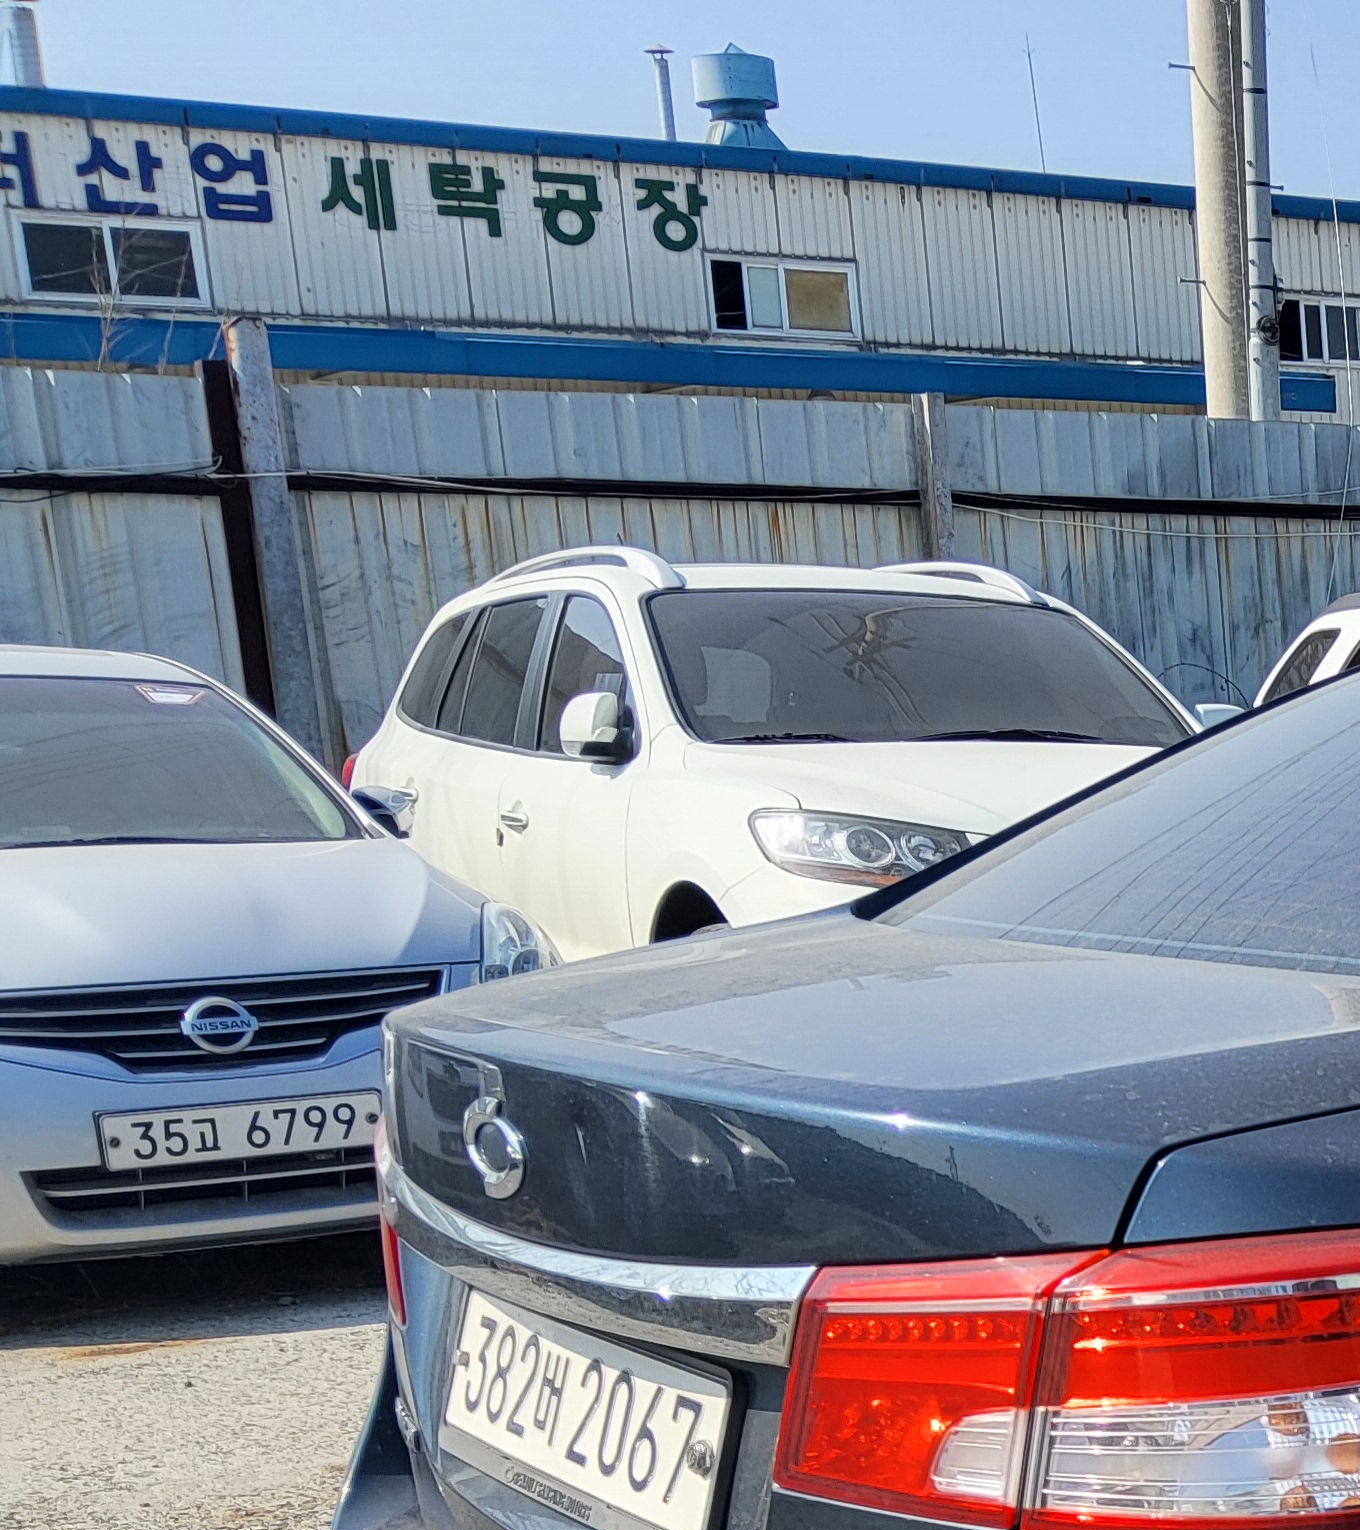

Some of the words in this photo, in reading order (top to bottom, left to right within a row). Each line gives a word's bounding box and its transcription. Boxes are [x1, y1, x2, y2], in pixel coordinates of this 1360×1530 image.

[321, 156, 709, 252] 세탁공장
[190, 1018, 252, 1032] NISSAN
[130, 1116, 222, 1161] 35고
[246, 1102, 356, 1149] 6799
[464, 1314, 571, 1447] 382버
[565, 1356, 704, 1505] 2067
